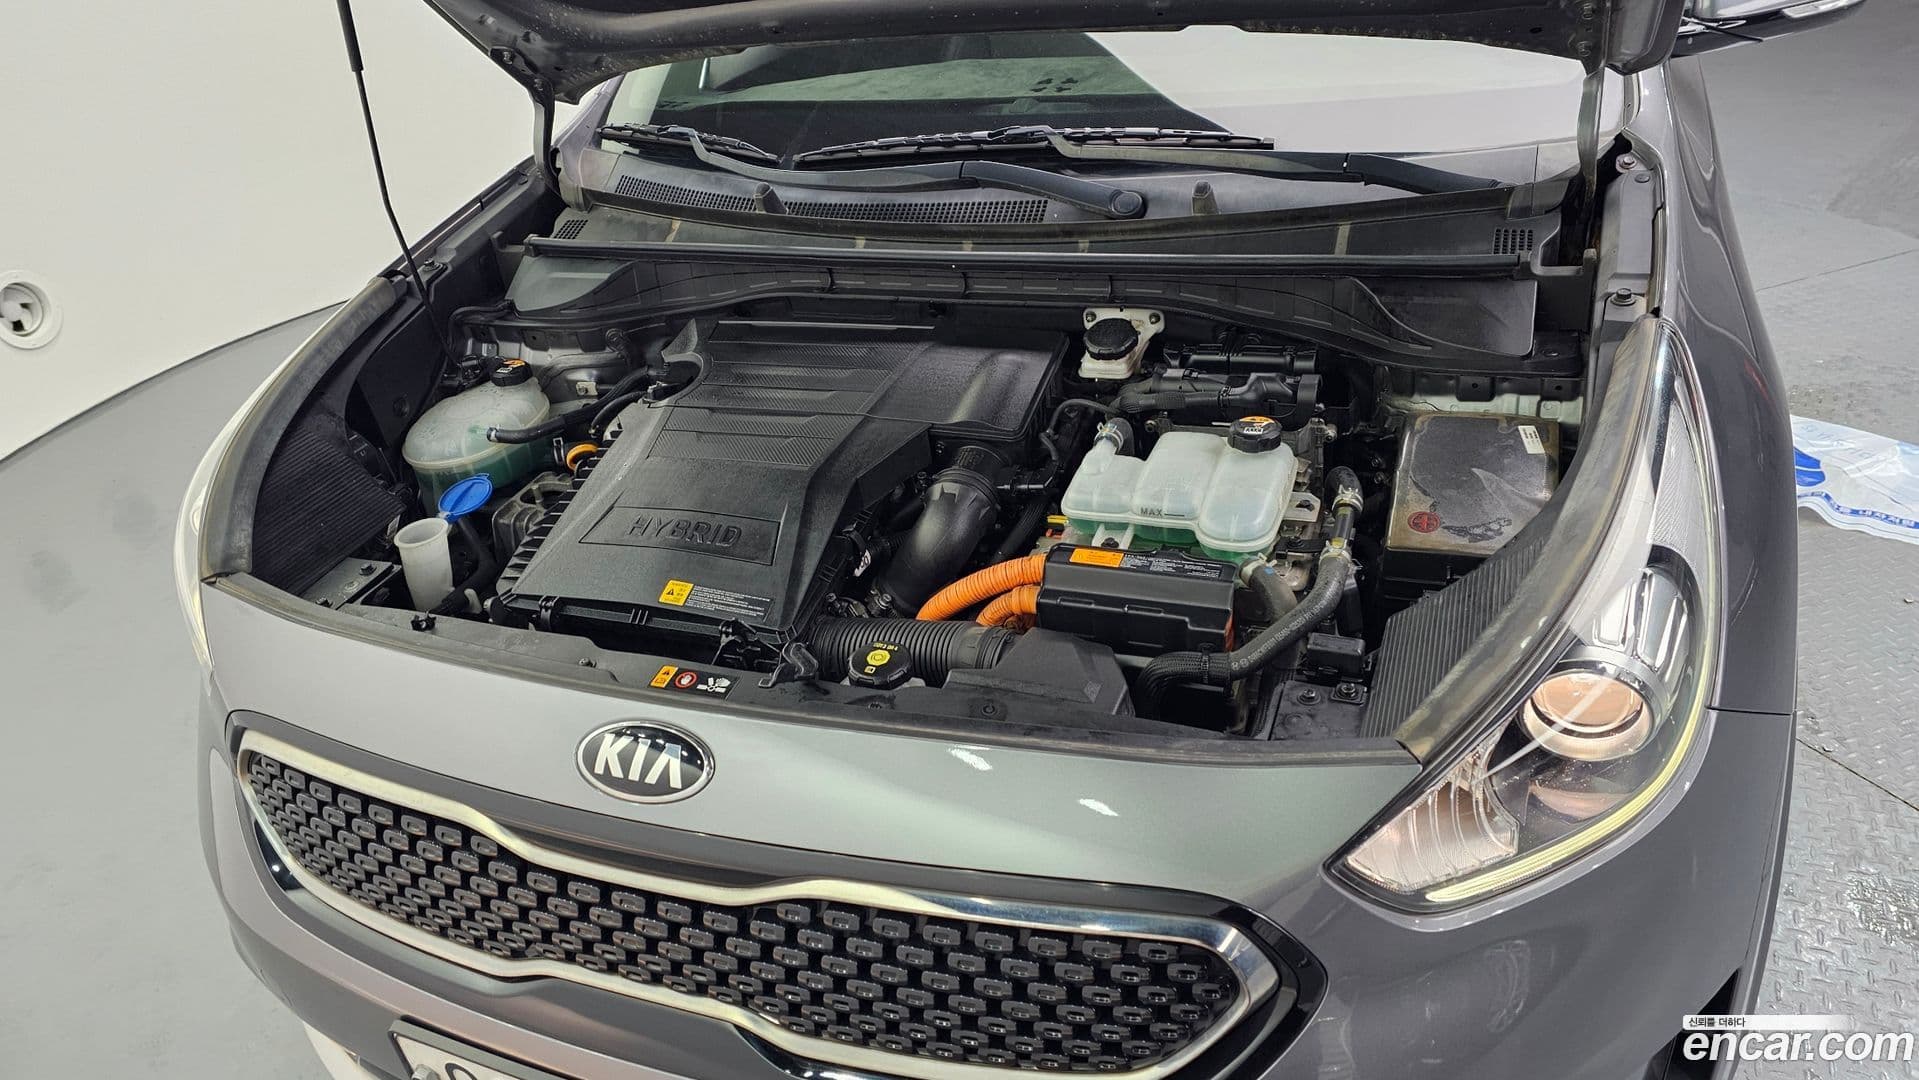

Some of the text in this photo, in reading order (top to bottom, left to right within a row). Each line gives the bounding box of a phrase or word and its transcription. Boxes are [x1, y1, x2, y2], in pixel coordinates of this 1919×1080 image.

[1140, 507, 1163, 517] MAX
[626, 514, 743, 548] HYBRID
[594, 733, 682, 789] KIA
